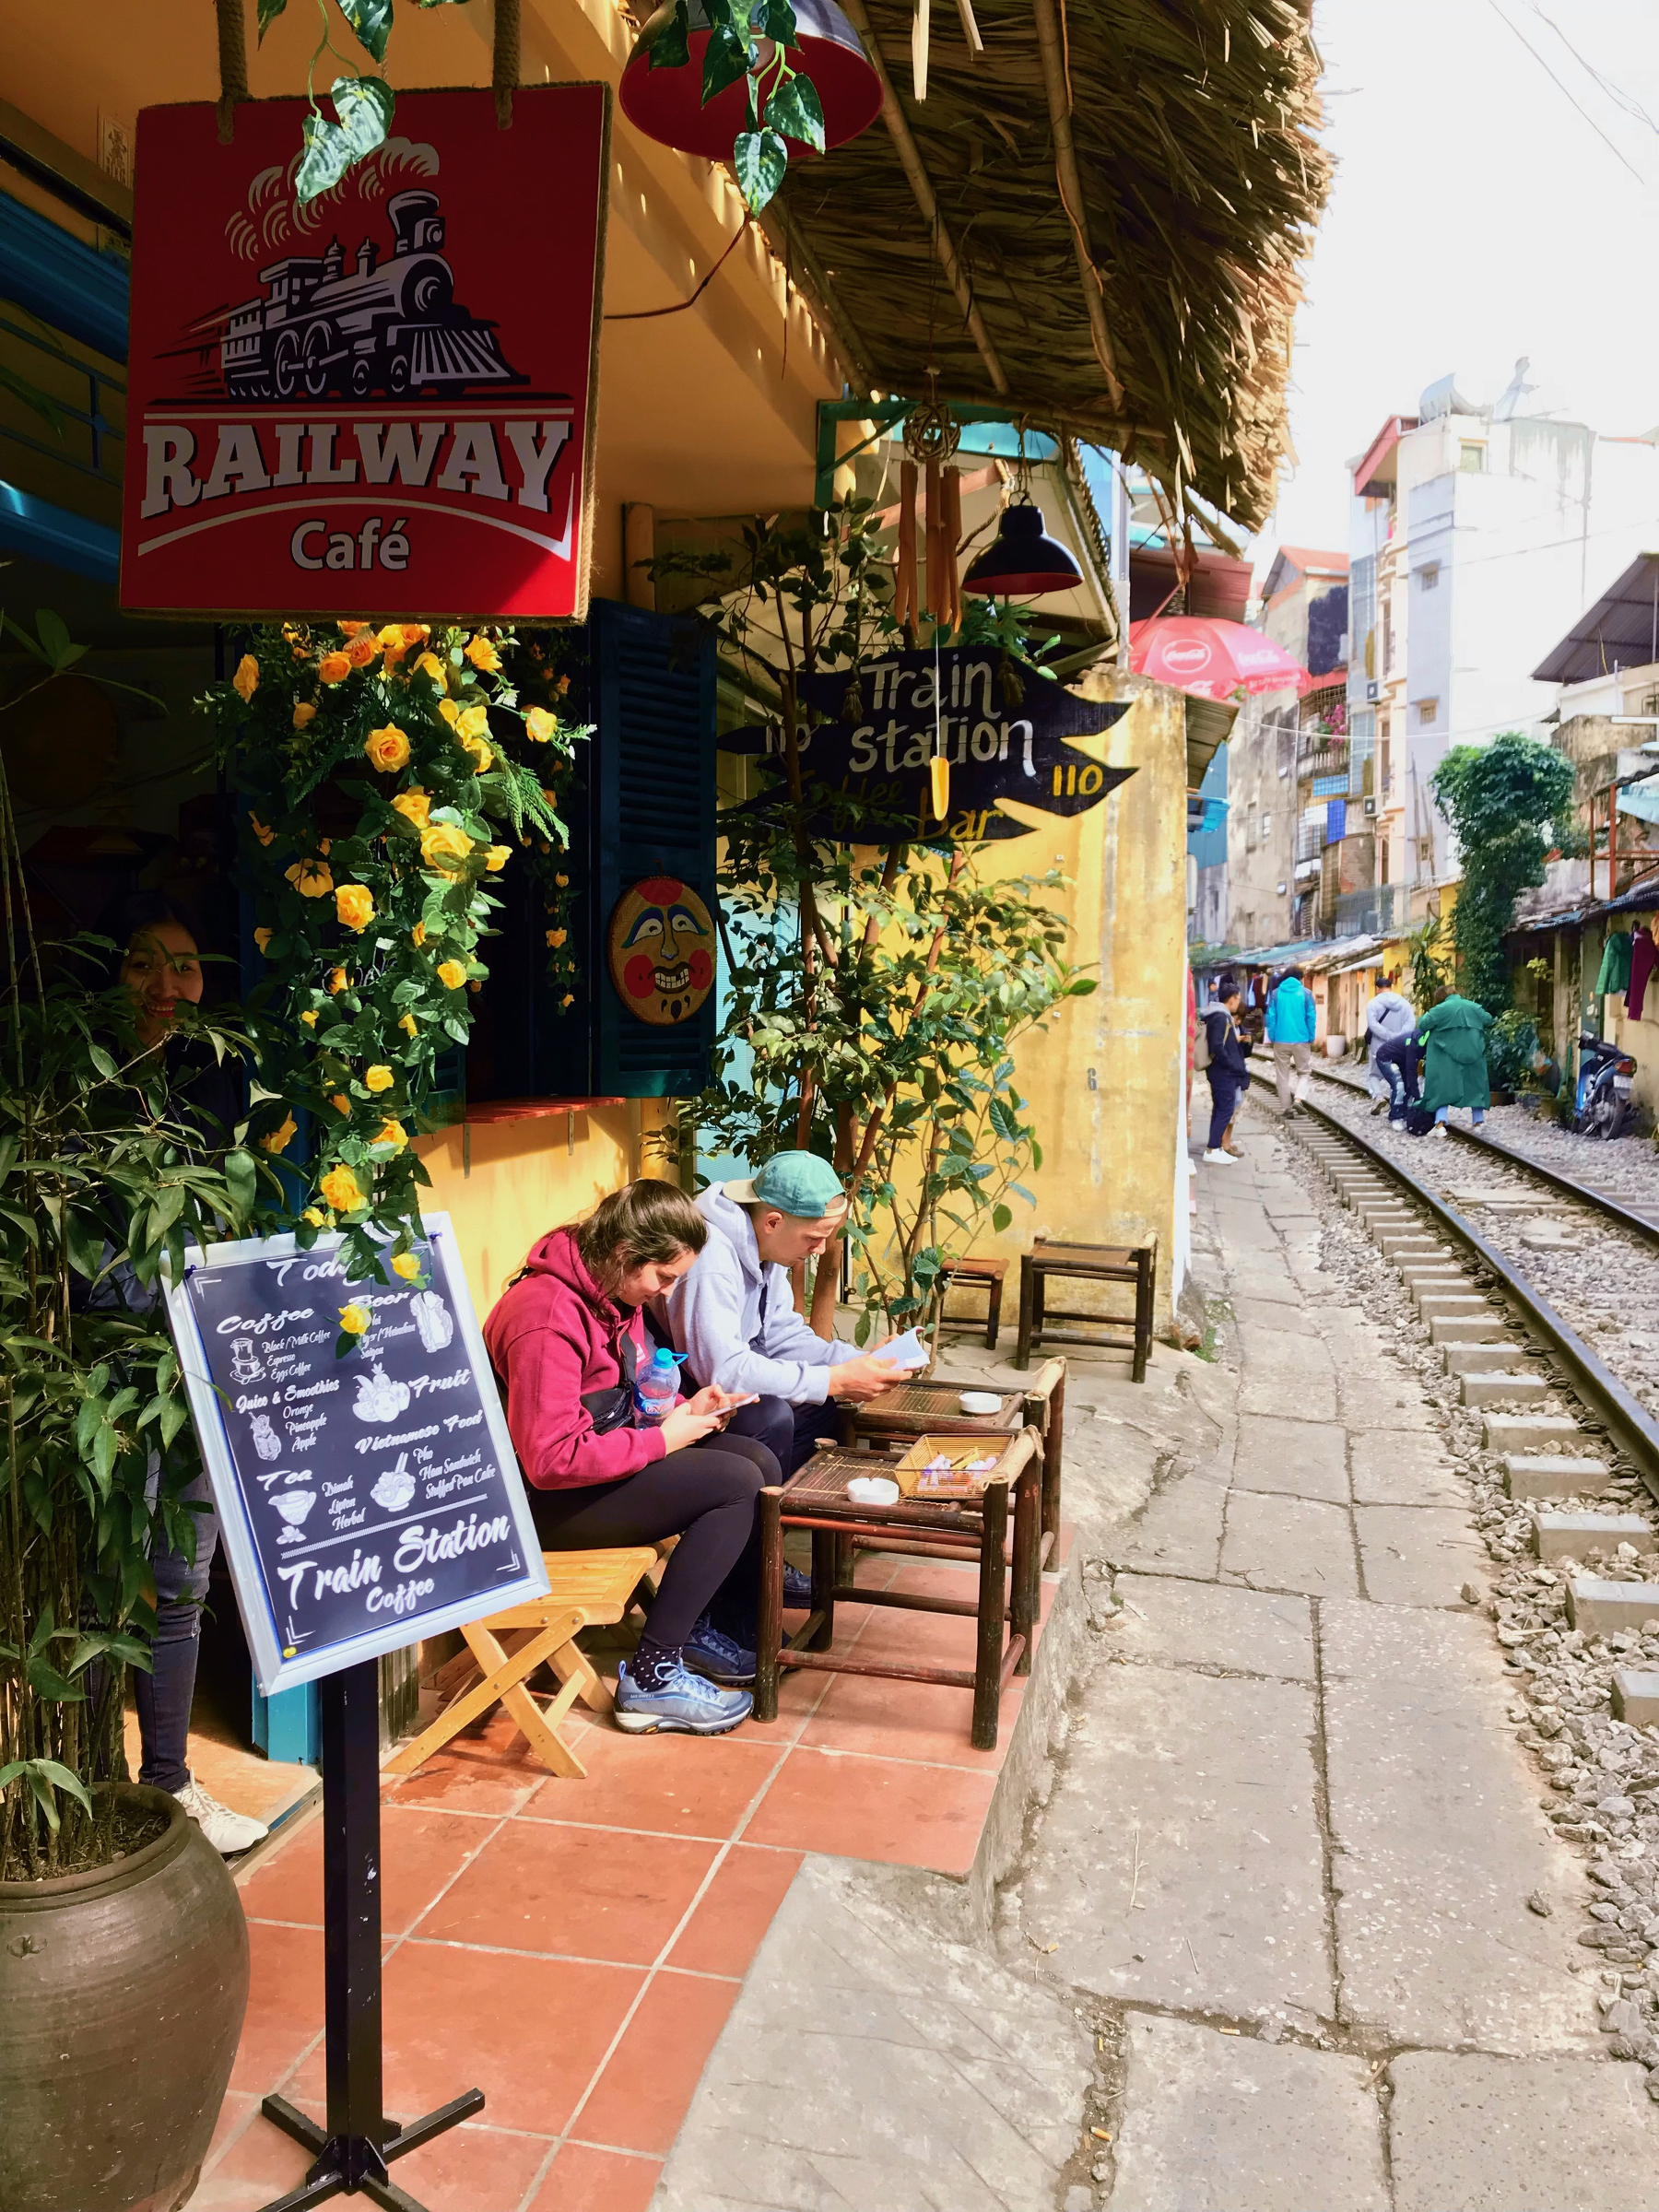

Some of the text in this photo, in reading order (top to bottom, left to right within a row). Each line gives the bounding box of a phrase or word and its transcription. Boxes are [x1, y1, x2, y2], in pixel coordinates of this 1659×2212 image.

[140, 420, 572, 521] RAILWAY
[290, 516, 411, 571] Café
[860, 653, 1002, 719] Train
[1052, 764, 1104, 796] 110
[216, 1307, 315, 1335] Coffee
[261, 1337, 285, 1353] Black
[309, 1329, 331, 1344] Coffee
[266, 1354, 296, 1368] Espresso
[270, 1361, 312, 1383] Eggs Coffee
[236, 1379, 340, 1414] Juice & Smoothies
[407, 1368, 472, 1398] Fruit
[283, 1403, 314, 1419] Orange
[285, 1412, 327, 1436] Pineapple
[291, 1432, 317, 1453] Apple
[354, 1408, 483, 1454] Vietnamese Food
[412, 1445, 434, 1465] Pho
[418, 1448, 481, 1481] Ham Sandwich
[256, 1469, 313, 1491] Tea
[453, 1474, 474, 1490] Pan
[474, 1464, 496, 1483] Cake
[328, 1497, 357, 1515] Lipton
[332, 1507, 367, 1531] Herbal
[276, 1512, 512, 1611] Train Station
[366, 1577, 435, 1614] Coffee
